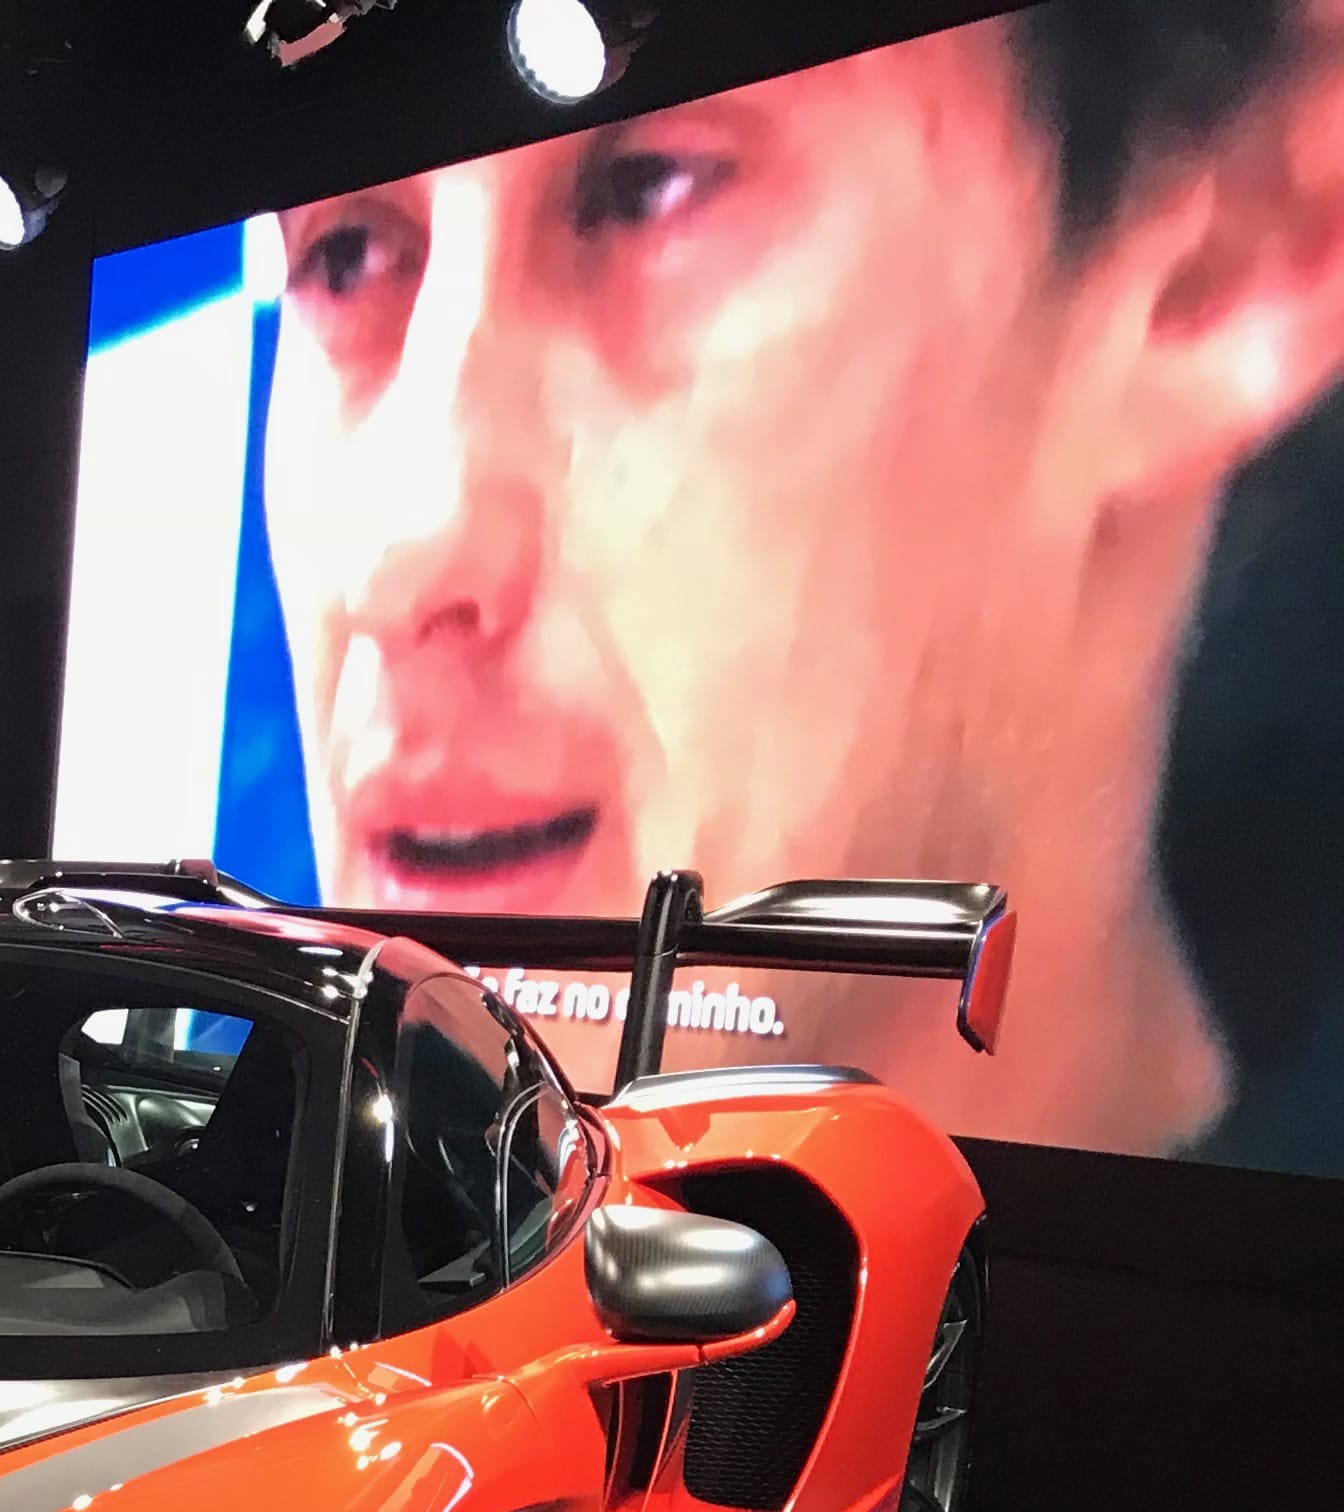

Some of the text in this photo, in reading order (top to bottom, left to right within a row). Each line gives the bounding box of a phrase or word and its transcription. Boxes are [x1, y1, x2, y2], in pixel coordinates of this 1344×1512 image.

[504, 968, 560, 1015] faz
[564, 981, 611, 1021] no
[616, 980, 785, 1036] cminho.
